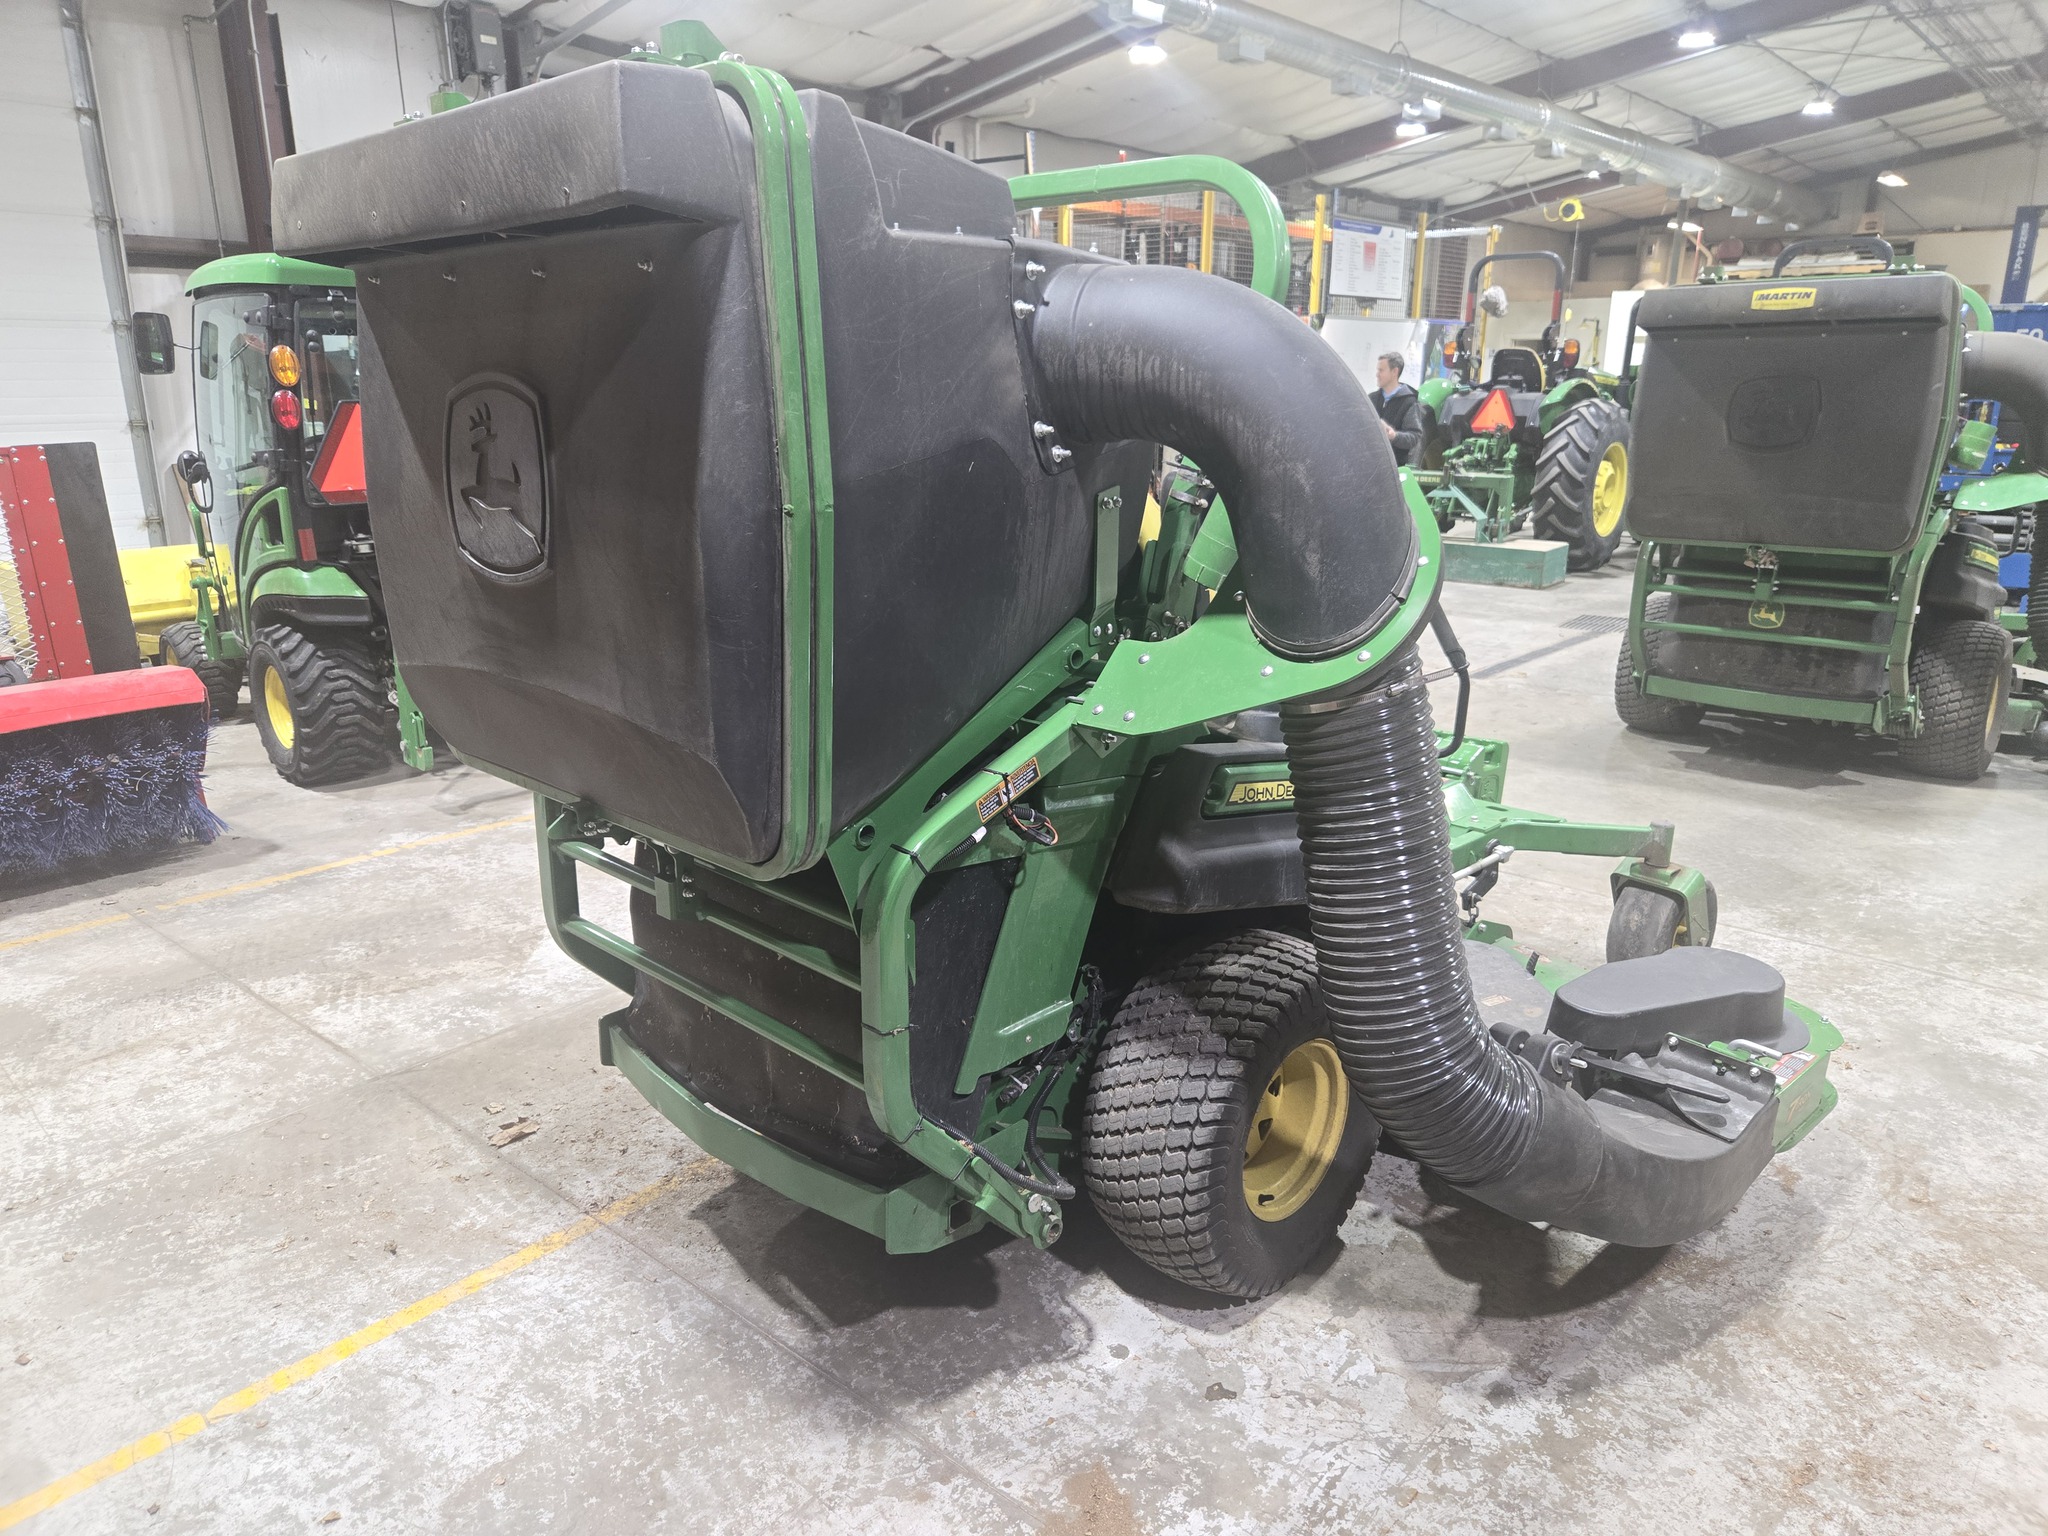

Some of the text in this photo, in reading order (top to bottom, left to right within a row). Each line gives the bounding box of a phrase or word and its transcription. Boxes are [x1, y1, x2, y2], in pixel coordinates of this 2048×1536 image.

[1757, 291, 1813, 301] MARTIN
[1239, 783, 1294, 801] JOHN DE
